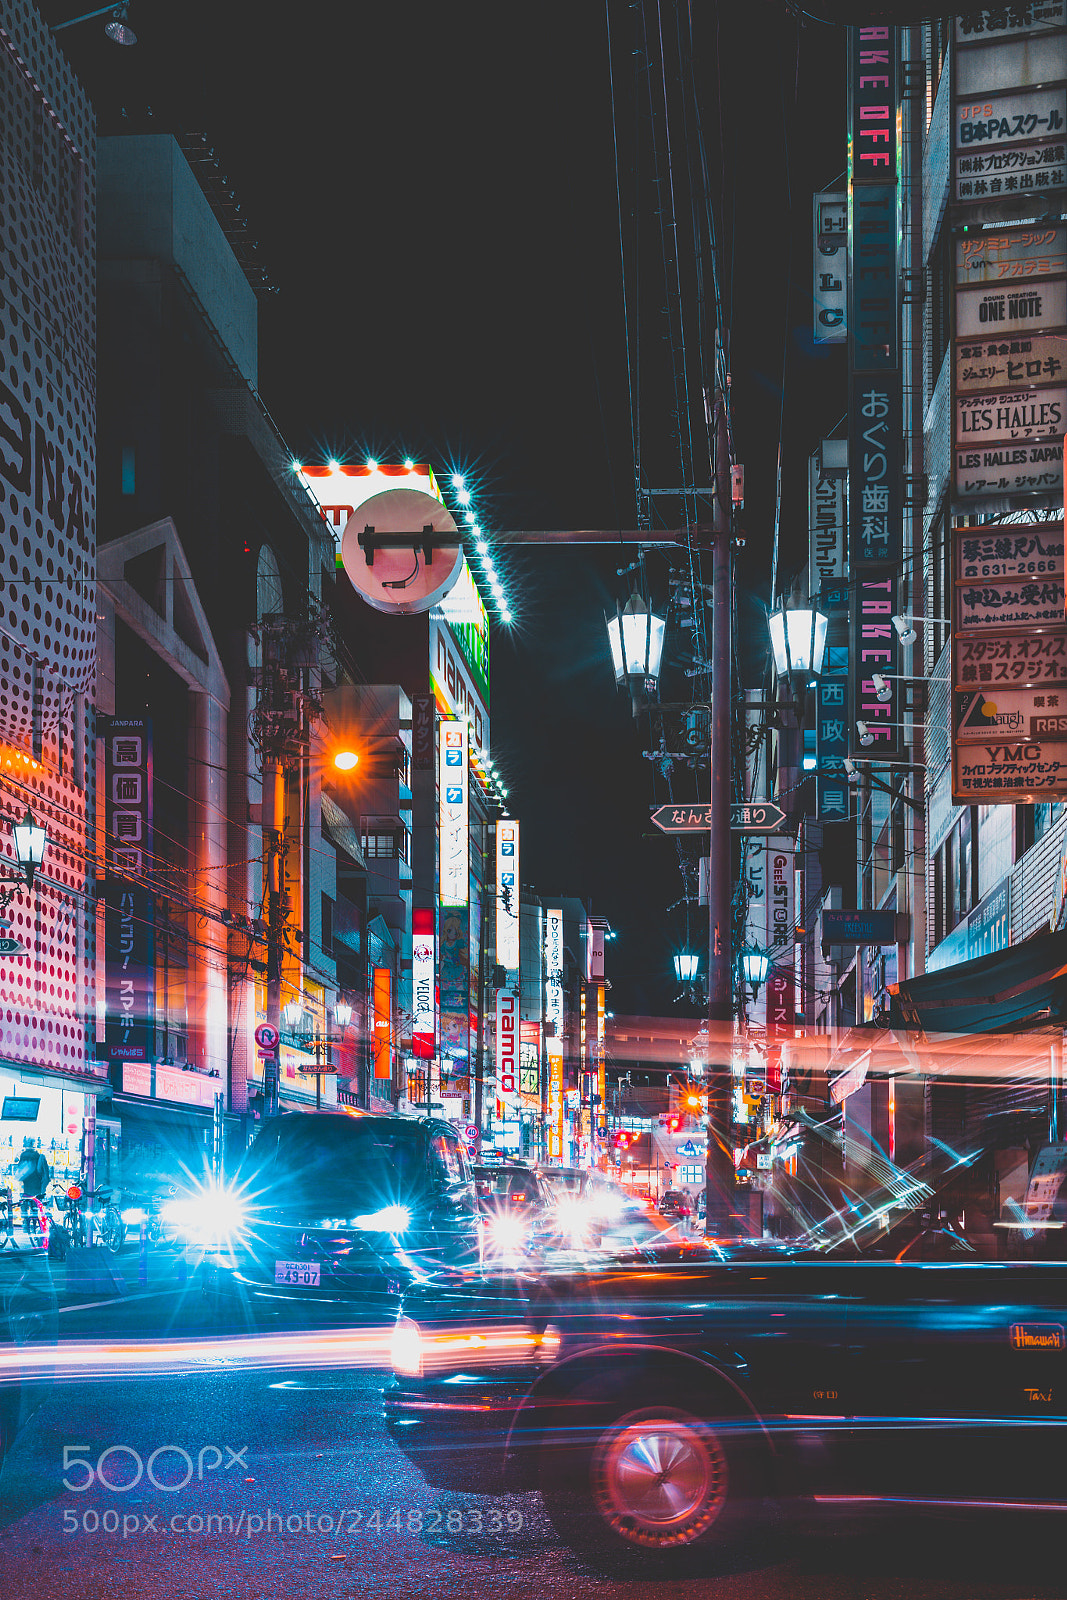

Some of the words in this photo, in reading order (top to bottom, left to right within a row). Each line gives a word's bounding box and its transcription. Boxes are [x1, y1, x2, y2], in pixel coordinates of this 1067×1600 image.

[859, 26, 889, 89] AKE
[961, 104, 993, 120] JPS
[859, 105, 889, 166] OFF
[960, 109, 1063, 143] 日本PAスクール
[961, 231, 1057, 254] サン・ミュージック
[998, 259, 1065, 278] アカデミー
[983, 294, 1006, 302] SOUND
[1007, 291, 1038, 300] CREATION
[979, 301, 1006, 323] ONE
[1008, 296, 1042, 320] NOTE
[961, 408, 994, 433] LES
[996, 402, 1062, 430] HALLES
[1010, 426, 1058, 438] レアール
[861, 389, 890, 545] おぐり歯科
[958, 453, 982, 469] LES
[983, 449, 1028, 467] HALLES
[965, 478, 1010, 492] レアール
[1014, 472, 1060, 487] ジャパン
[981, 560, 1057, 576] 631-2666
[861, 579, 892, 663] TAKE
[861, 680, 892, 741] OFF
[1033, 695, 1060, 708] 喫茶
[820, 683, 846, 814] 西政家具
[985, 746, 1042, 762] YMC
[446, 731, 463, 804] カラケ
[671, 807, 766, 824] なん通り
[501, 829, 515, 885] カラケ
[773, 978, 788, 1042] ジースト
[375, 1020, 390, 1028] au
[110, 1048, 144, 1058] じゃんぱら
[501, 996, 515, 1093] namco
[284, 1270, 318, 1285] 49-07
[1013, 1325, 1060, 1348] Himawari
[1023, 1388, 1053, 1402] Taxi
